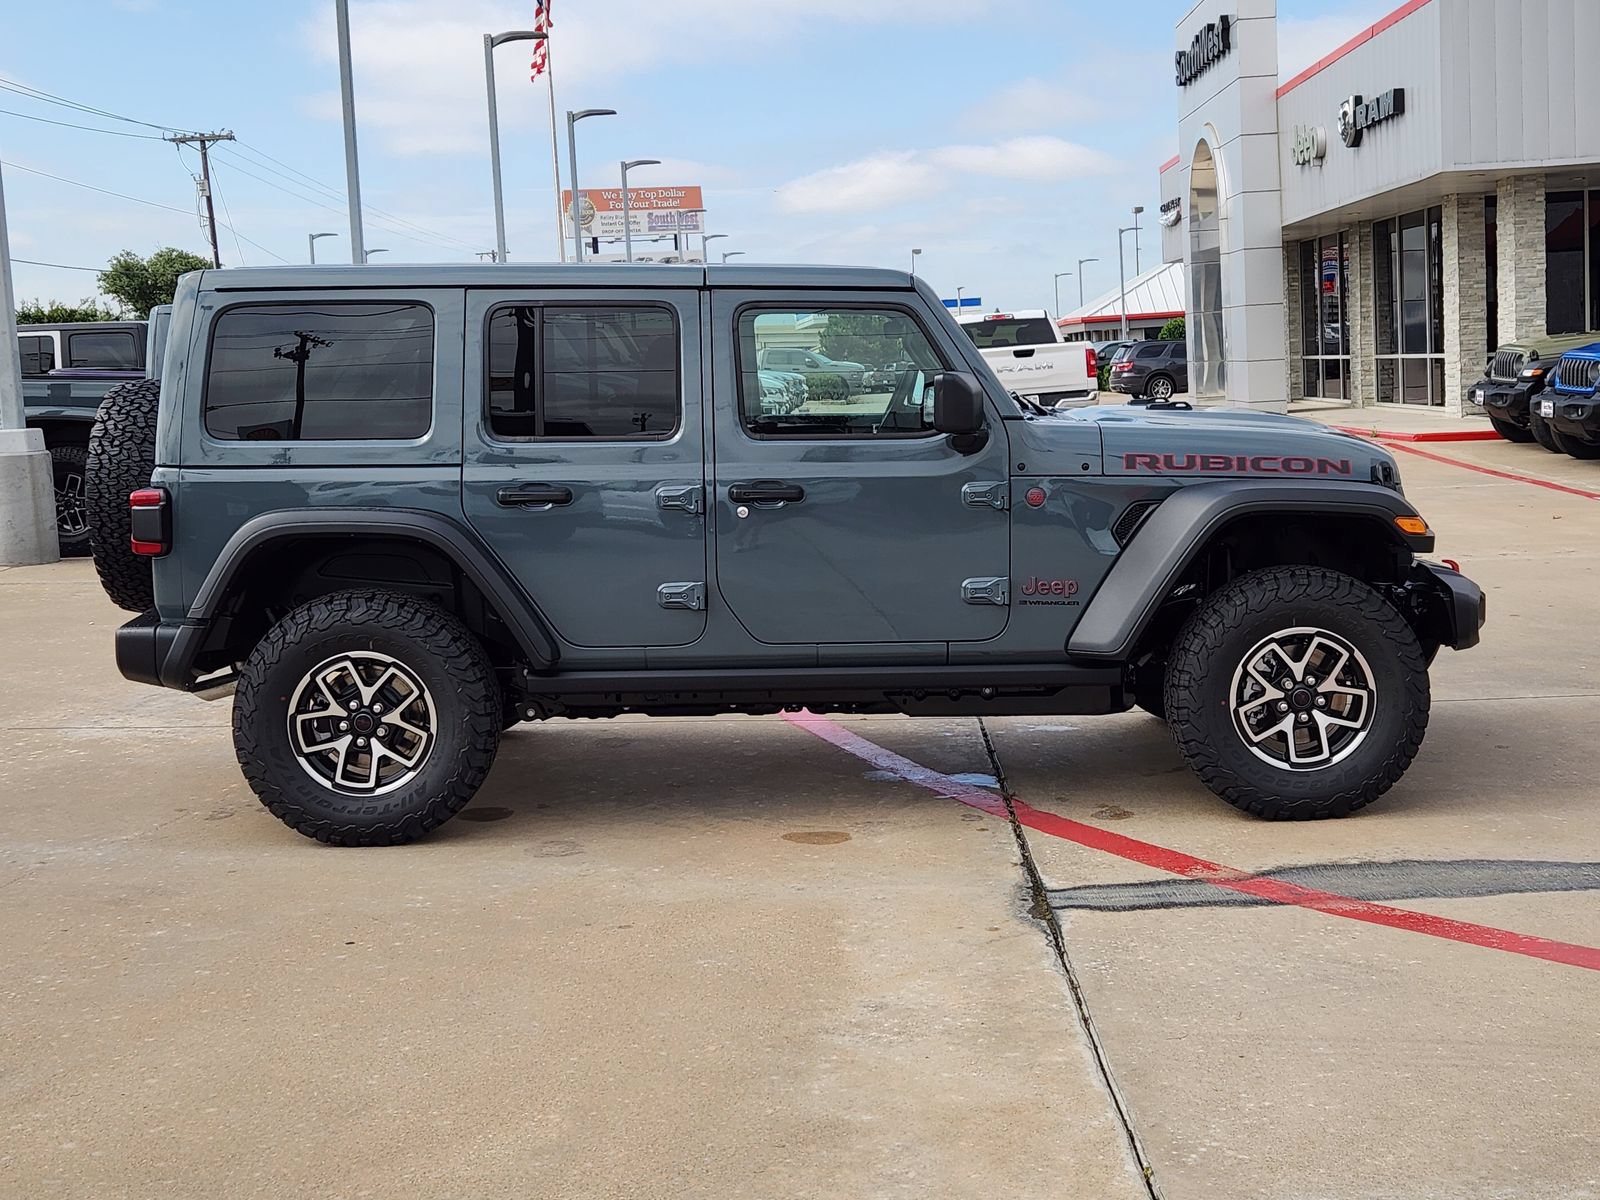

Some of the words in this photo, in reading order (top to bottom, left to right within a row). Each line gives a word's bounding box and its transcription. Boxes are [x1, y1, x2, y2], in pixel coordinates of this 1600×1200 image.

[1355, 88, 1405, 130] RAM
[1292, 125, 1325, 167] Jeep
[602, 191, 617, 200] We
[639, 190, 656, 199] Top
[658, 189, 686, 197] Dollar
[609, 201, 624, 209] For
[627, 200, 650, 208] Your
[651, 199, 680, 207] Trade!
[1124, 453, 1352, 474] RUBICON
[1022, 576, 1078, 598] Jeep
